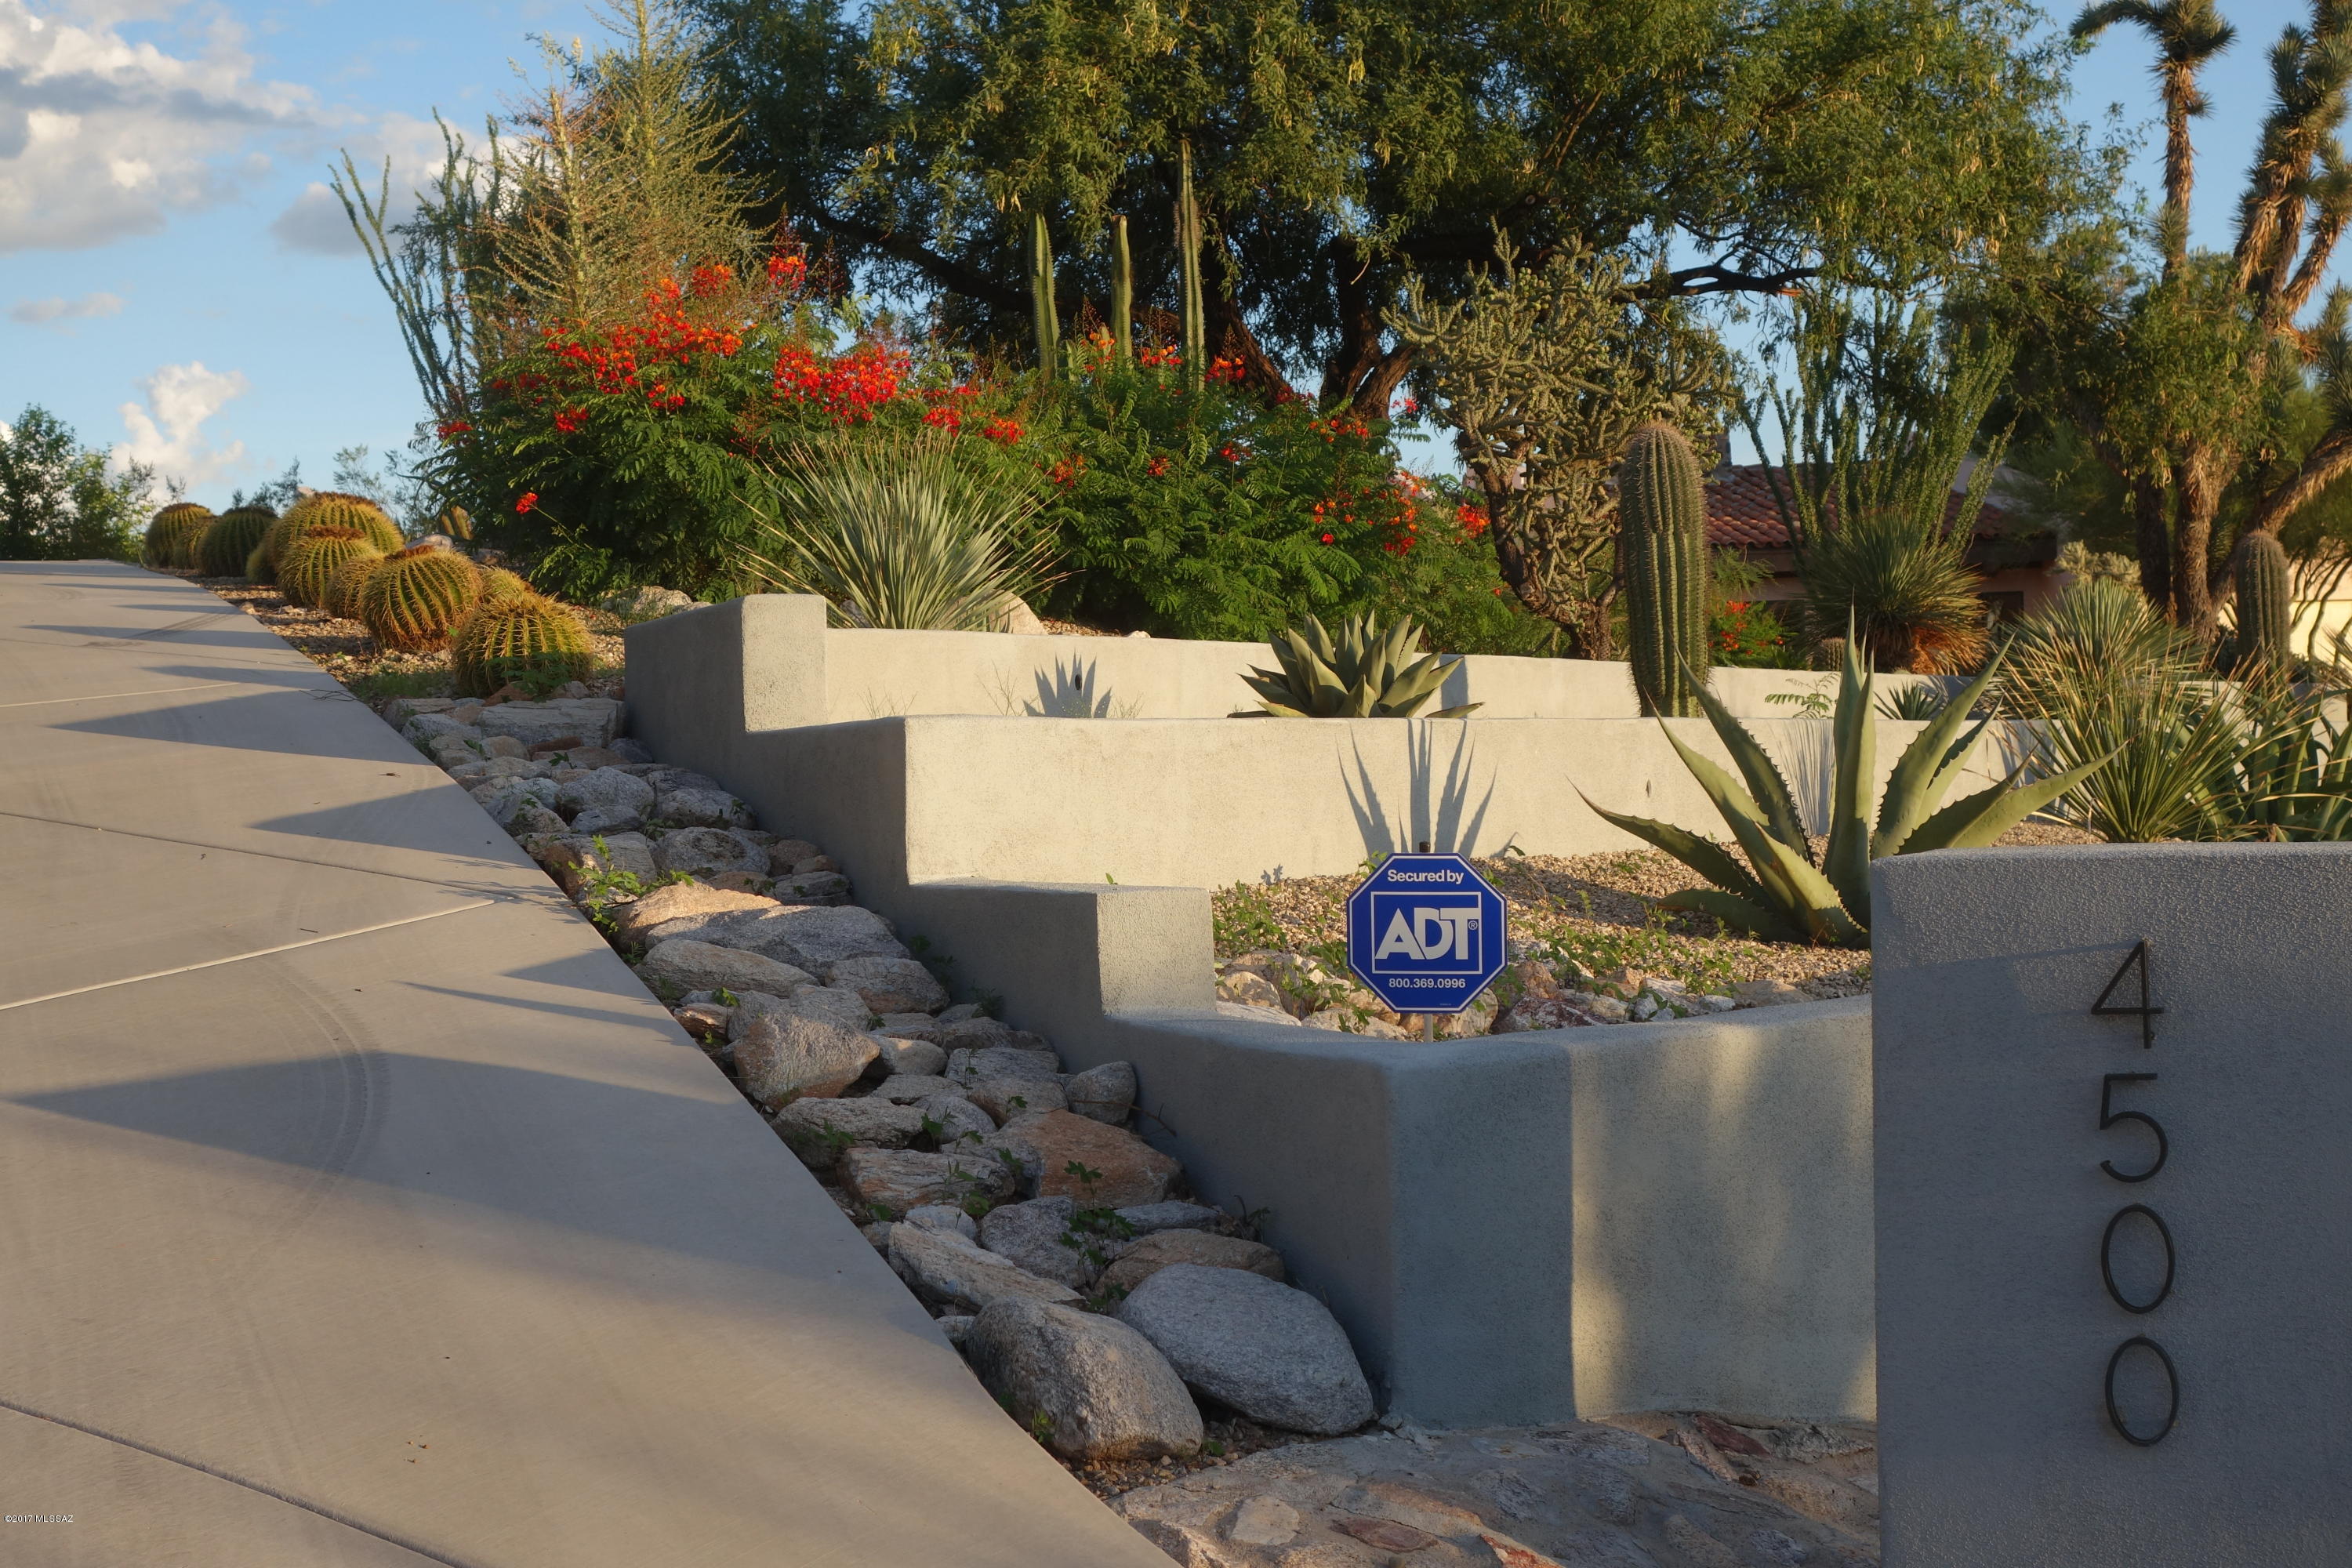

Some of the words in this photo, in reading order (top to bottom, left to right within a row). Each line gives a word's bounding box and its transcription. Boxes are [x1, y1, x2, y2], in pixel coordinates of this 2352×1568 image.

[1387, 869, 1445, 882] Secured
[1446, 869, 1464, 884] by
[1388, 978, 1465, 988] 800.369.0996
[2091, 940, 2180, 1446] 4500
